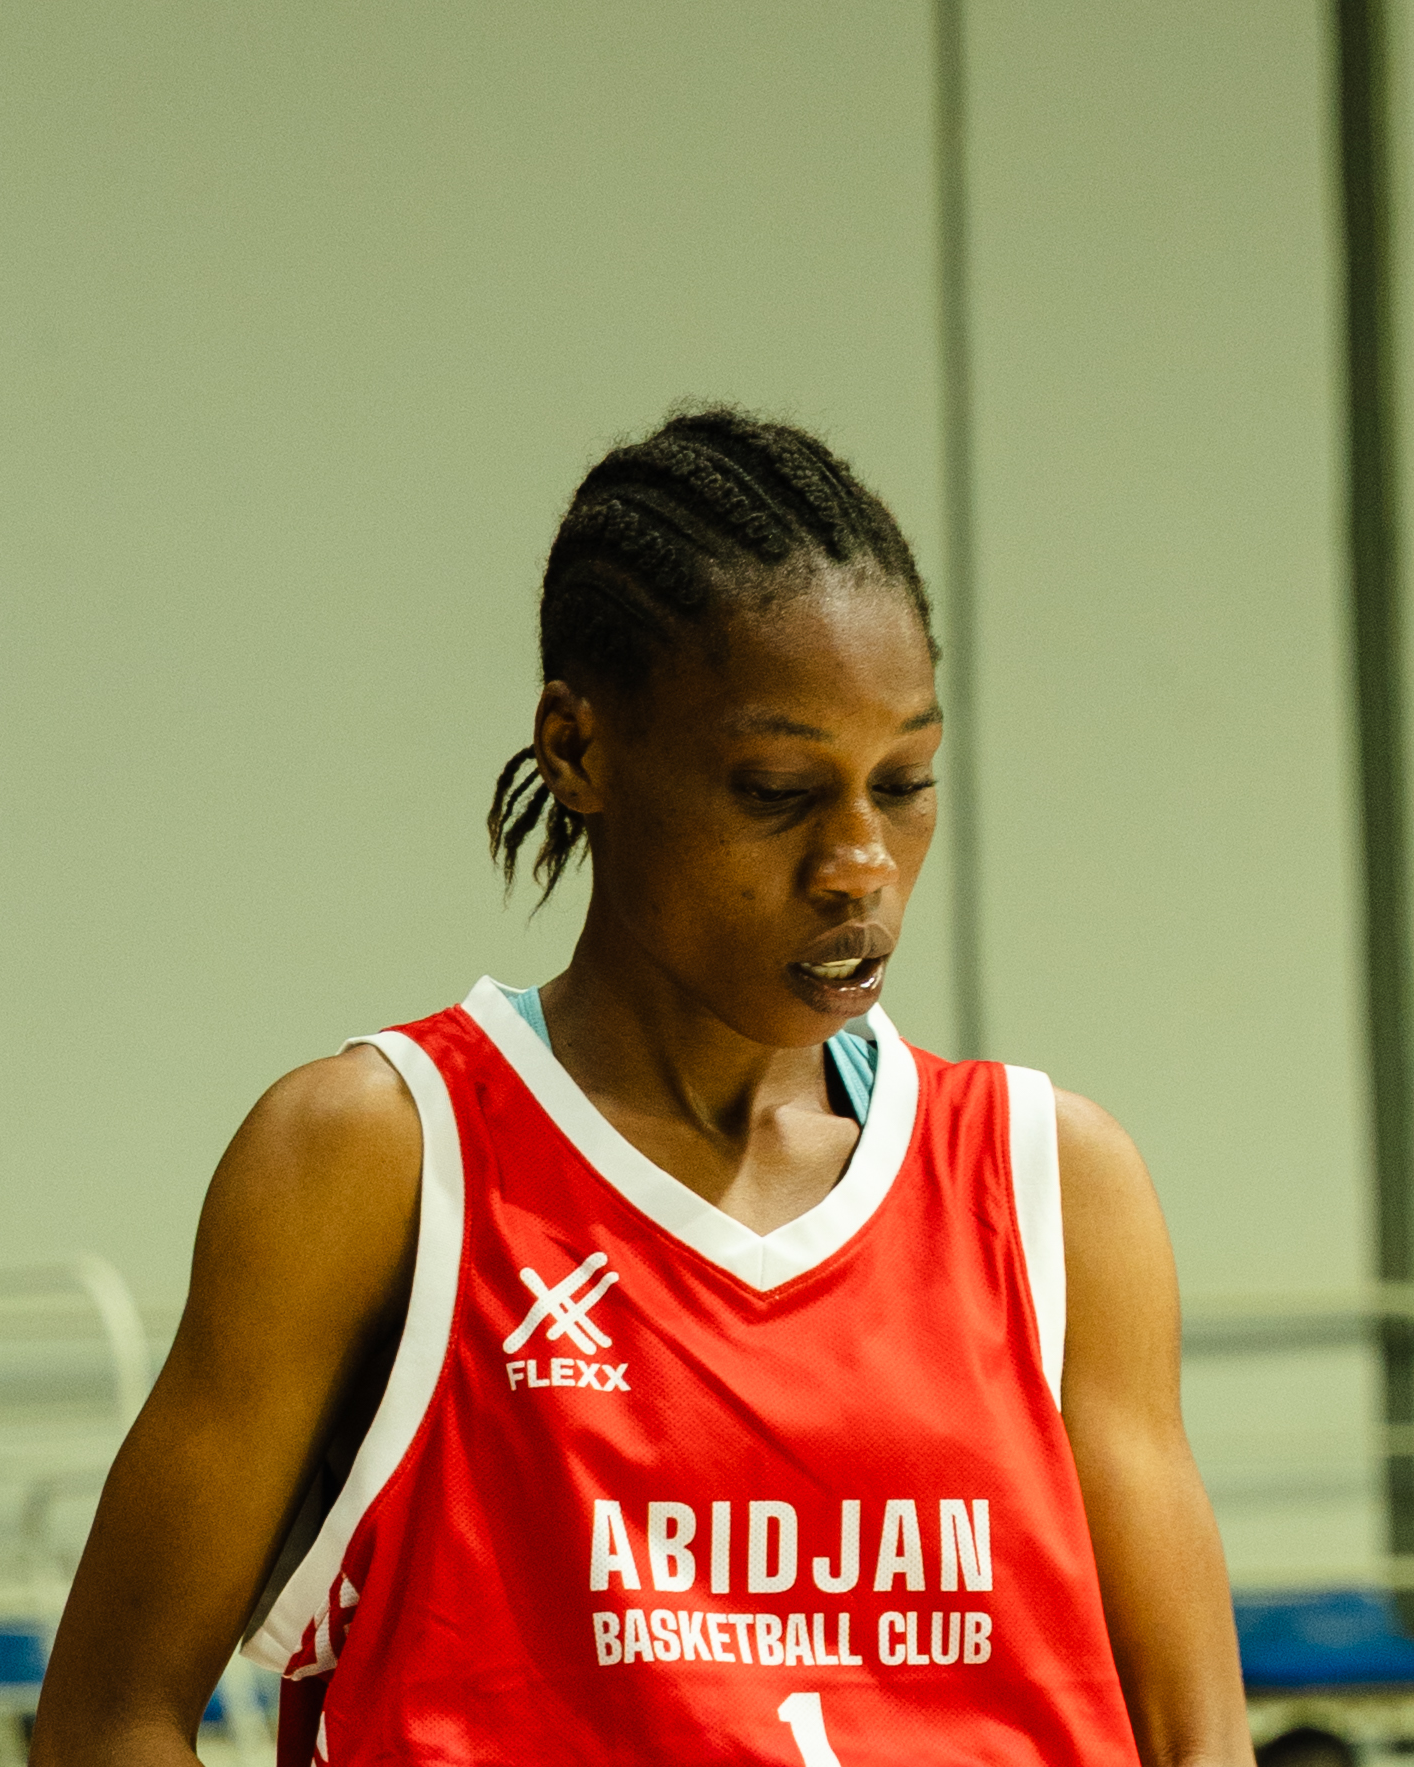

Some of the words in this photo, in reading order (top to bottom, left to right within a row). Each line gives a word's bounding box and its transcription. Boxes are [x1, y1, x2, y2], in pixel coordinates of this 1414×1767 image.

[505, 1357, 632, 1393] FLEXX
[588, 1499, 994, 1594] ABIDJAN
[592, 1609, 863, 1667] BASKETBALL
[878, 1610, 993, 1666] CLUB
